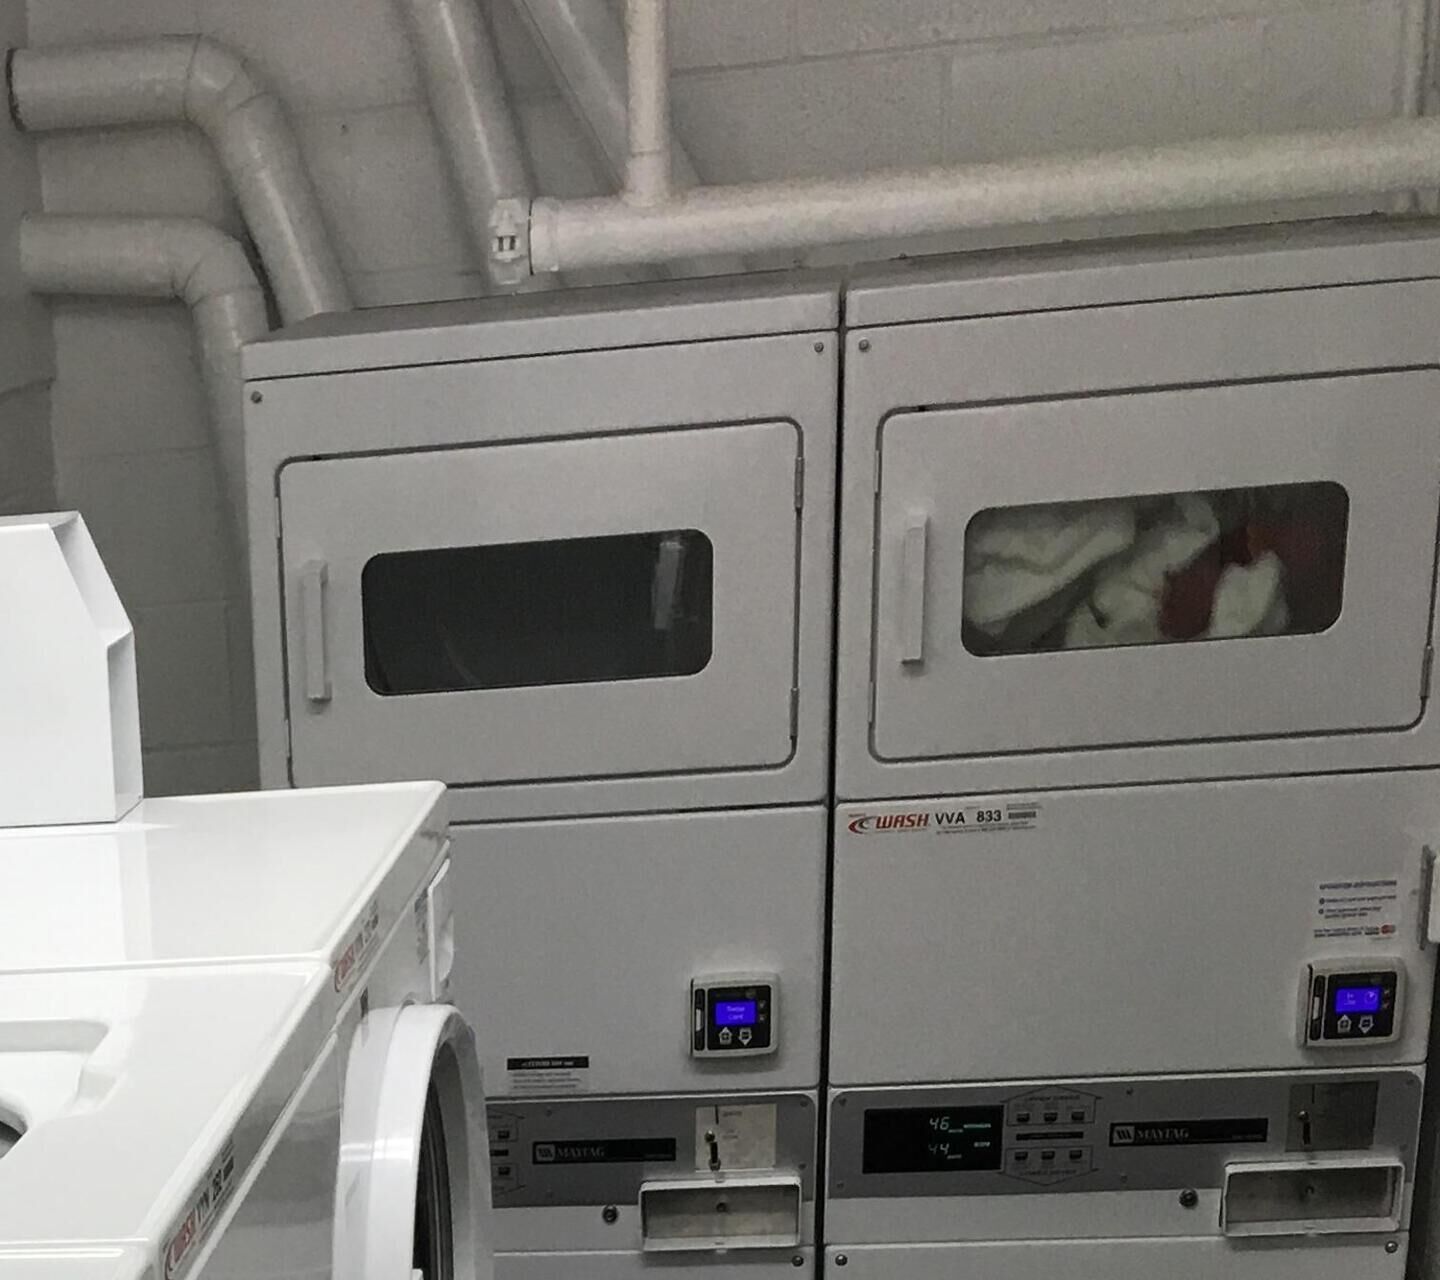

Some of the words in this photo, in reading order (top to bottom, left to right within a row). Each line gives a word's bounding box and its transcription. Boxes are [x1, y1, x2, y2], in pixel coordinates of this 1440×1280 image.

[876, 813, 930, 829] WASH
[935, 811, 966, 825] VVA
[976, 809, 1002, 823] 833
